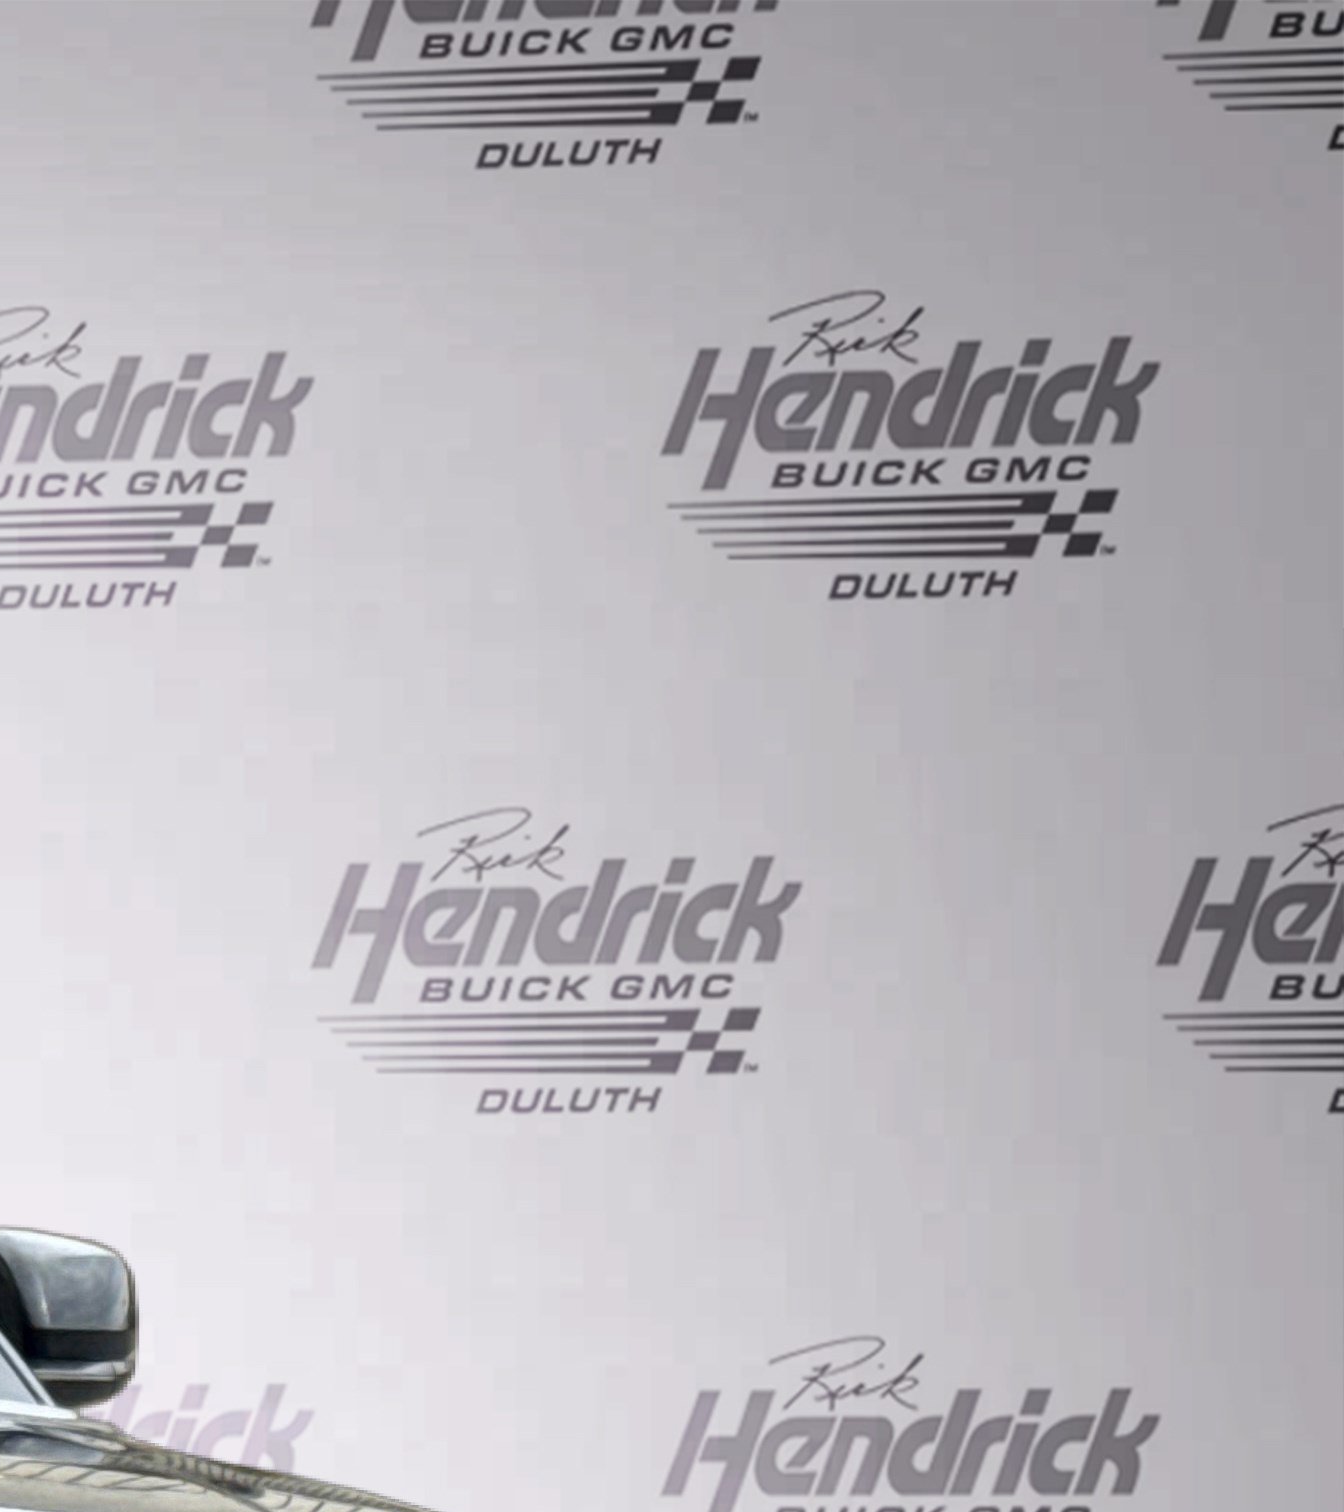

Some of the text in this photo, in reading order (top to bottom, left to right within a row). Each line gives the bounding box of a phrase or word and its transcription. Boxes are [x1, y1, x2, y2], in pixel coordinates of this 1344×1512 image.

[418, 26, 593, 60] BUICK
[609, 22, 736, 53] GMC
[474, 137, 663, 171] DULUTH
[659, 335, 1162, 492] Hendrick
[125, 467, 248, 497] GMC
[769, 454, 1092, 489] BUICK GMC
[827, 569, 1019, 601] DULUTH
[310, 855, 803, 1005] Hendrick
[418, 972, 735, 1004] BUICK GMC
[475, 1086, 663, 1115] DULUTH
